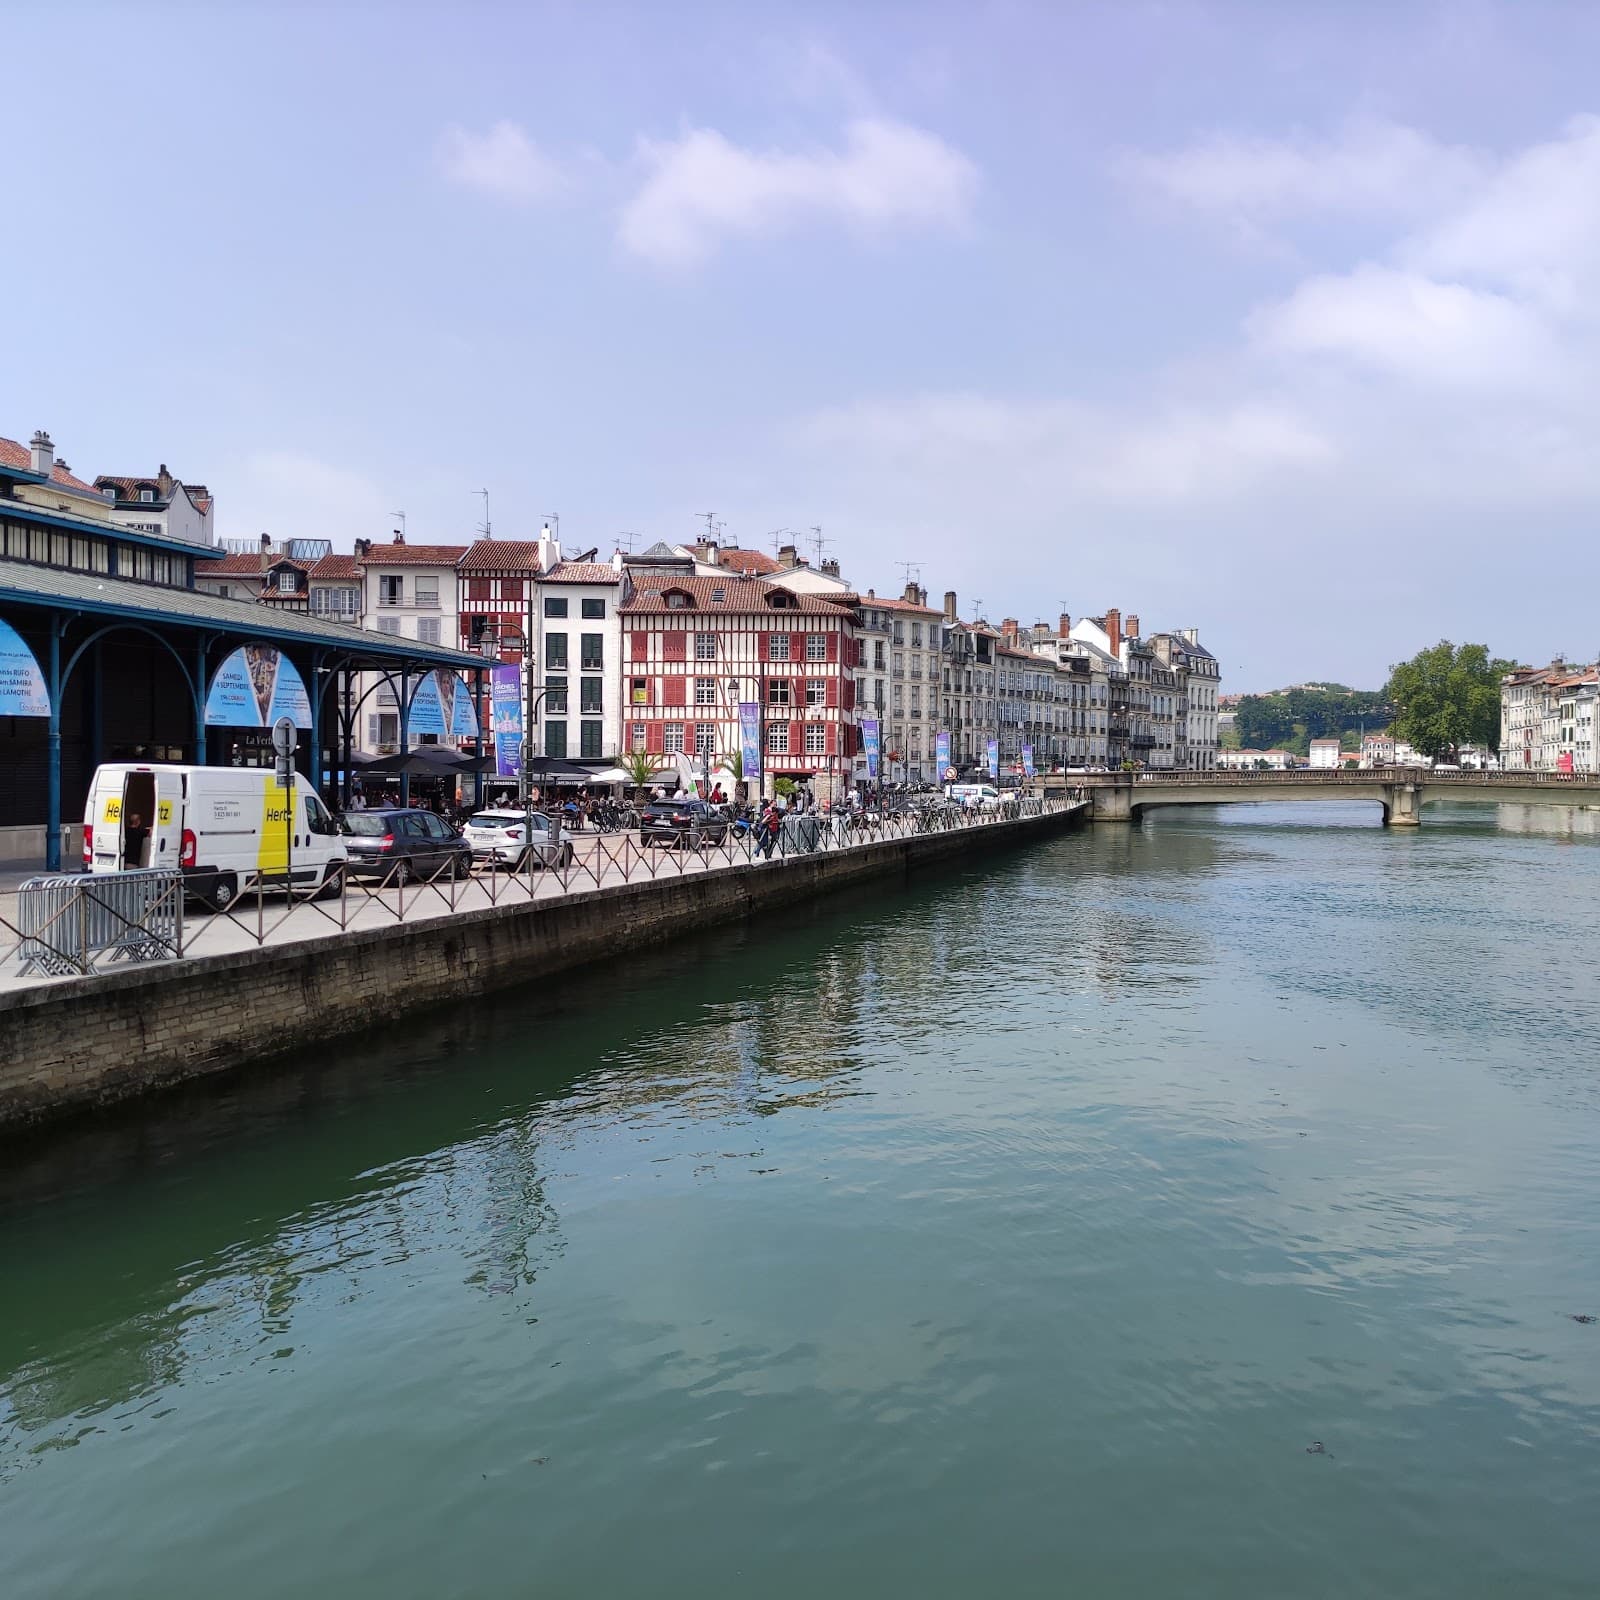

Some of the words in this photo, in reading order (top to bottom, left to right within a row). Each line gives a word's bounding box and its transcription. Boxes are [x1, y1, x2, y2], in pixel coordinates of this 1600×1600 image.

[13, 669, 30, 677] RUFO
[222, 673, 243, 681] SAMEDI
[3, 688, 32, 697] LAMOTHE
[246, 735, 255, 745] La
[105, 803, 121, 818] He
